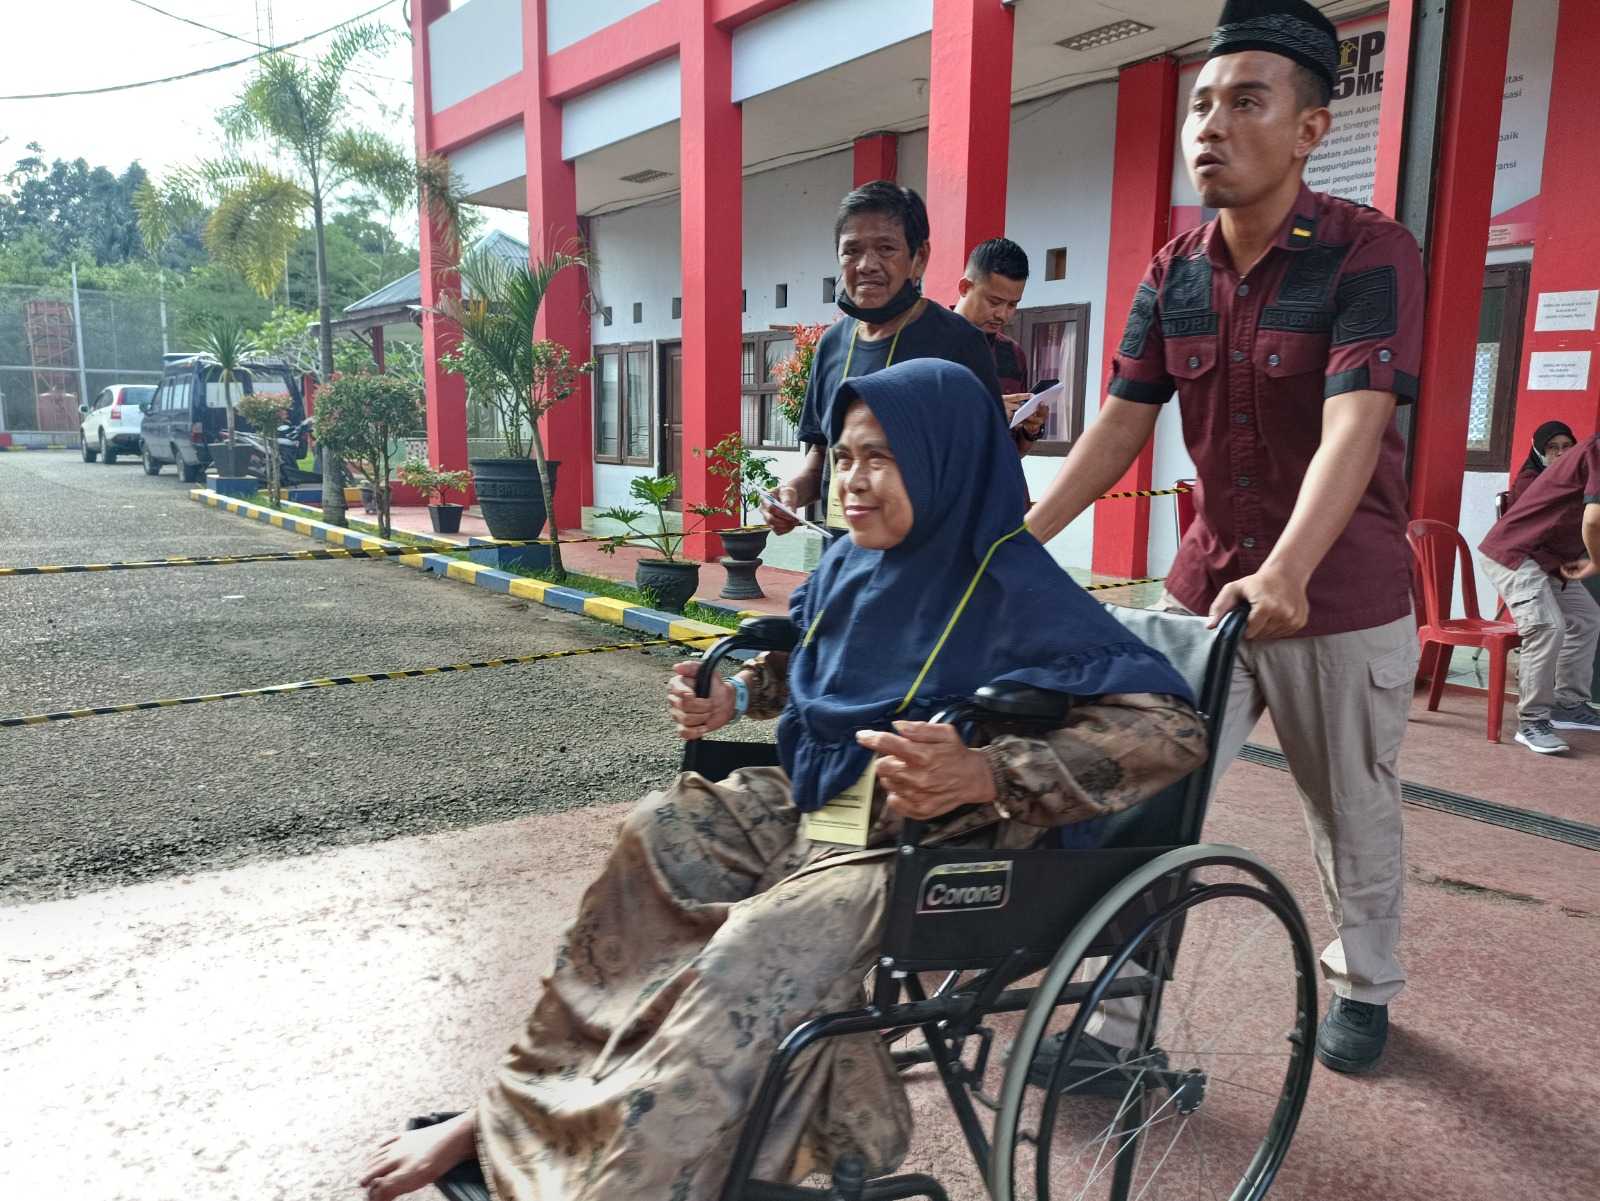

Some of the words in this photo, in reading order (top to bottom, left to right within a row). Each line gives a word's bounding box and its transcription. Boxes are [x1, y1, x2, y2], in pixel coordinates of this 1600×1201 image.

[1354, 131, 1371, 141] dan
[1342, 144, 1372, 157] adalah
[925, 882, 1004, 906] Corona
